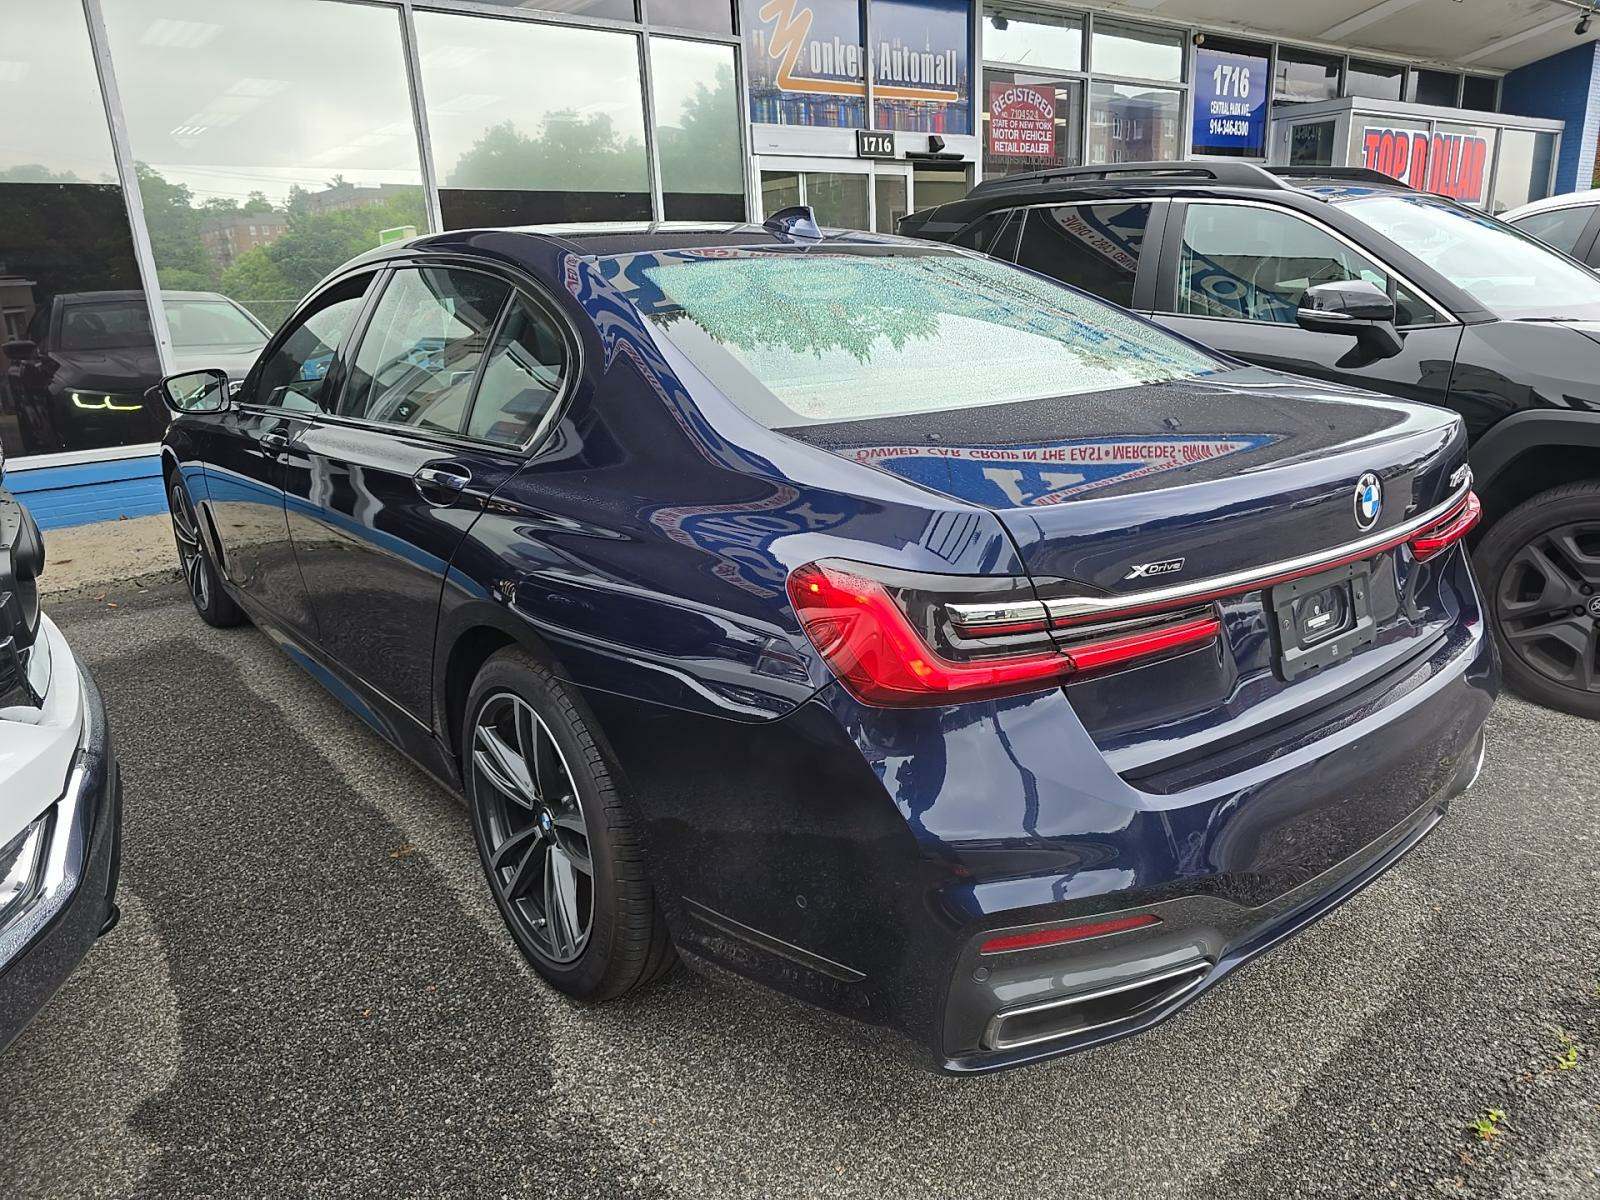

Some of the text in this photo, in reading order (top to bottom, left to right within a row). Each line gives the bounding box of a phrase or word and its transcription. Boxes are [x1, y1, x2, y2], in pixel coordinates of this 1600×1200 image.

[879, 42, 957, 86] Automall
[1213, 64, 1250, 98] 1716
[992, 87, 1054, 119] REGISTERED
[992, 119, 1052, 130] STATE OF NEW YORK
[992, 129, 1052, 142] MOTOR VEHICLE
[863, 136, 892, 152] 1716
[994, 142, 1049, 154] RETAIL DEALER
[1363, 129, 1487, 202] TOP DOLLAR
